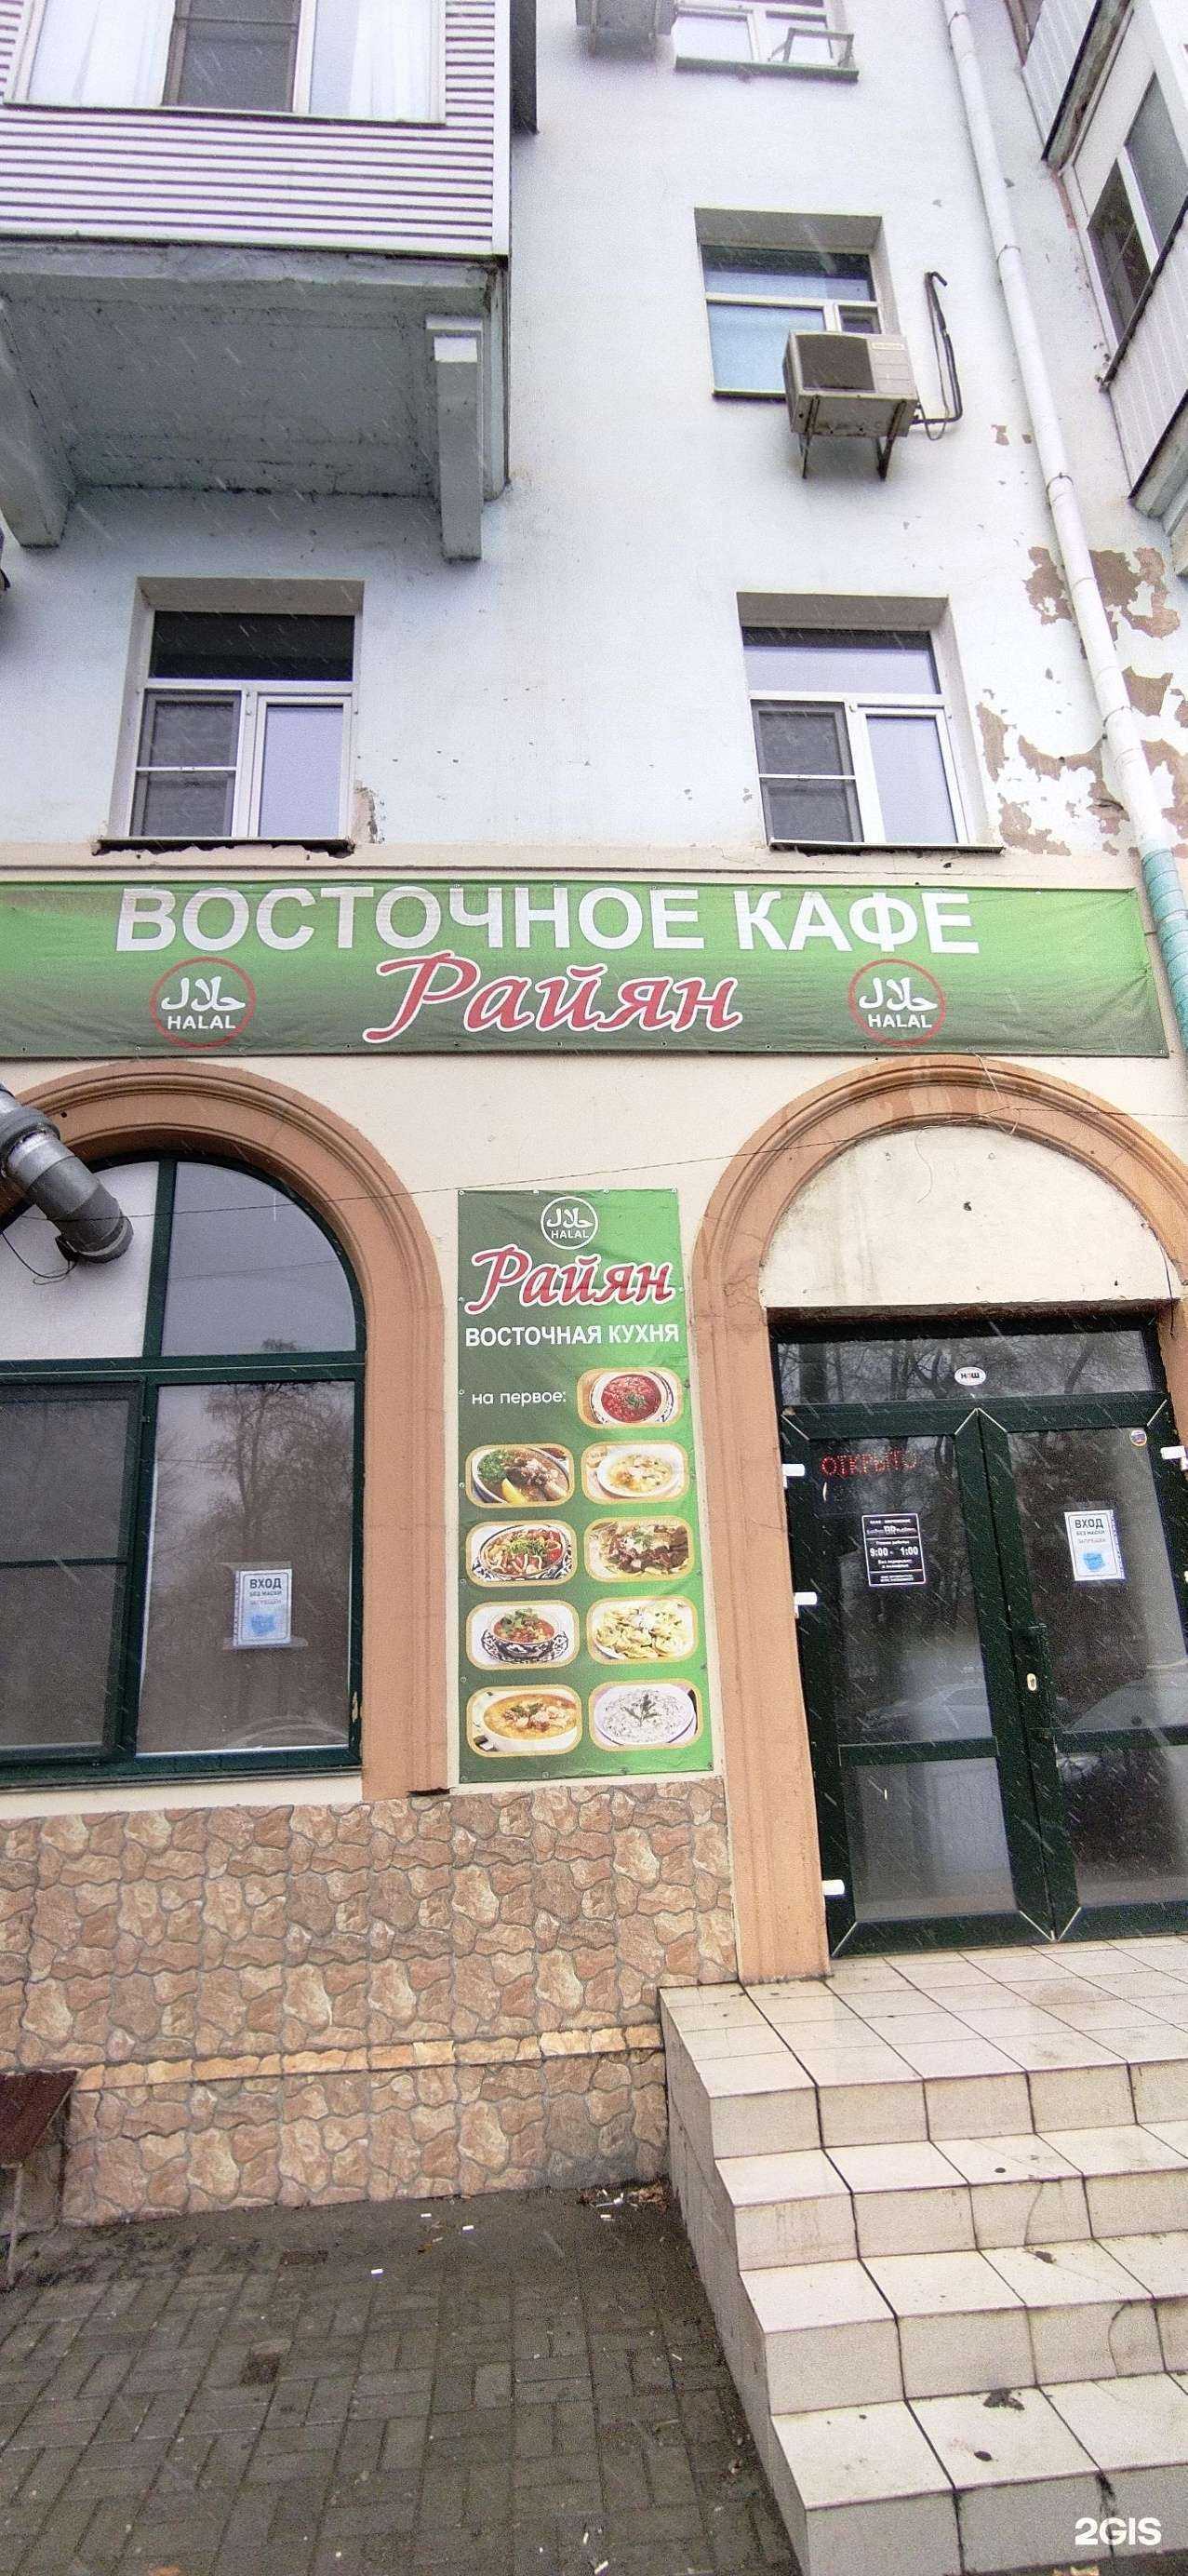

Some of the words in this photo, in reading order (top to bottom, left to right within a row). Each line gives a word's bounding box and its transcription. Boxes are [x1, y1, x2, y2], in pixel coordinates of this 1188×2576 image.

[115, 886, 704, 951] ВОСТОЧНОЕ
[733, 890, 981, 954] КАФЕ
[161, 975, 246, 1013] حلال
[362, 949, 743, 1043] Райян
[859, 976, 939, 1012] حلال
[167, 1014, 236, 1030] HALAL
[868, 1013, 932, 1028] HALAL
[546, 1207, 594, 1228] حلال
[551, 1229, 590, 1240] HALAL
[465, 1243, 674, 1315] Райян
[465, 1324, 602, 1348] ВОСТОЧНАЯ
[608, 1323, 680, 1344] КУХНЯ
[472, 1393, 494, 1404] на
[501, 1390, 567, 1407] первое:
[1075, 1518, 1103, 1530] ВХОД
[869, 1547, 888, 1557] 9:00
[249, 1577, 282, 1590] ВХОД
